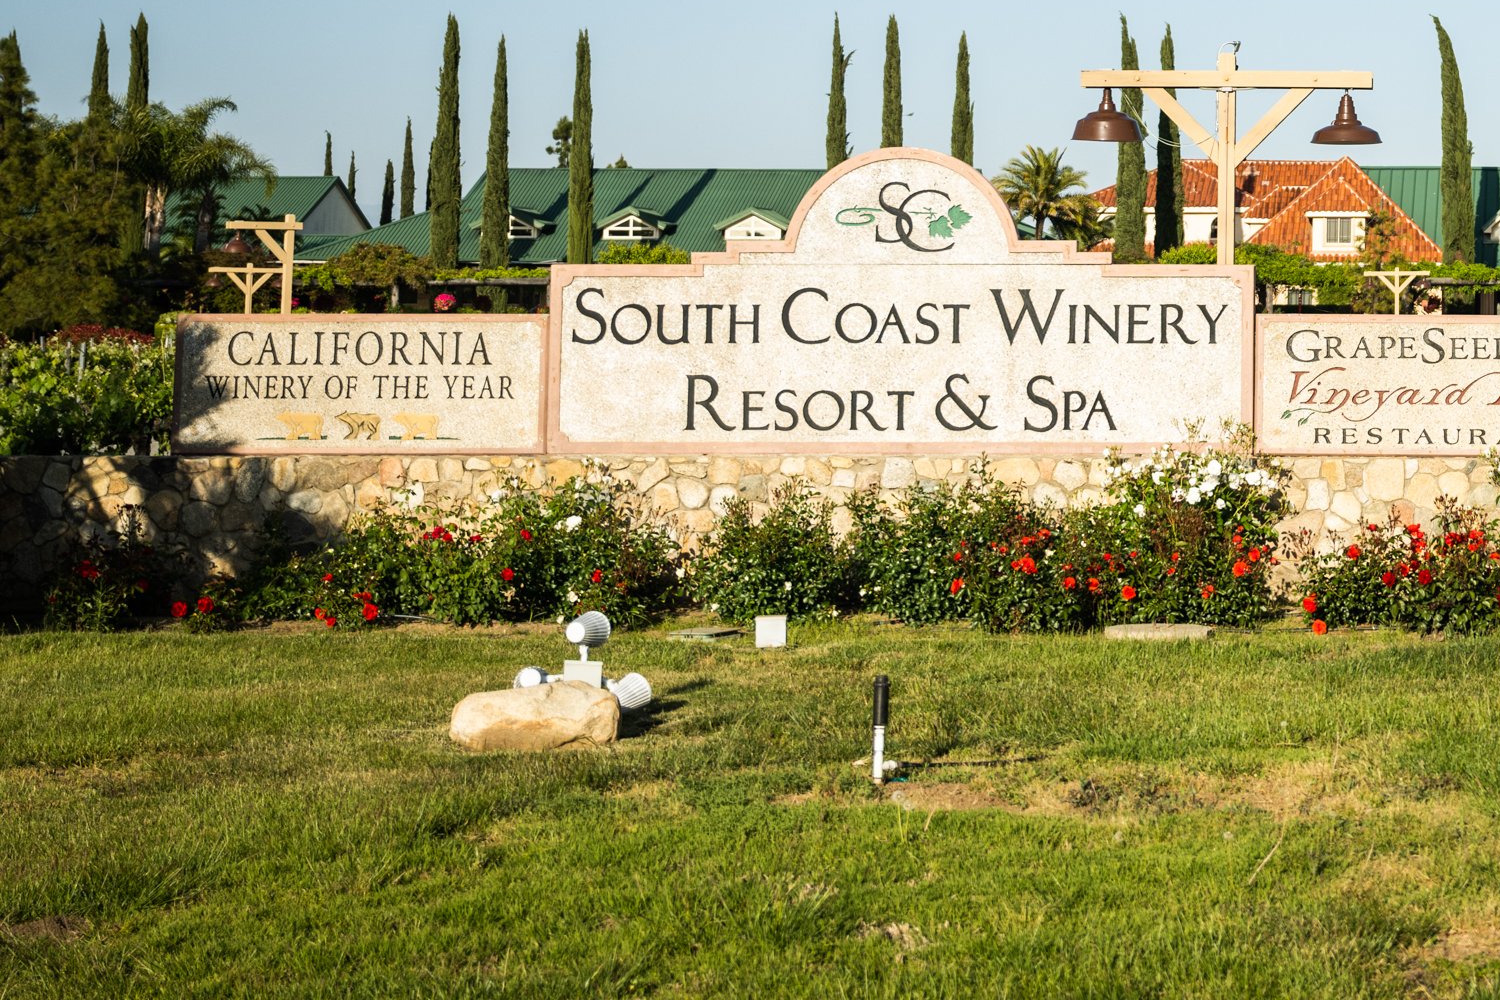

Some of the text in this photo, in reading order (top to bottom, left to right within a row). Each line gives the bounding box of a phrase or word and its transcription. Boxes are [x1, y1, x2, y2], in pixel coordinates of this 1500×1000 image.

[571, 287, 1228, 345] SOUTH COAST WINERY
[228, 331, 492, 366] CALIFORNIA
[205, 375, 514, 400] WINERY OF THE YEAR
[684, 373, 1118, 432] RESORT & SPA
